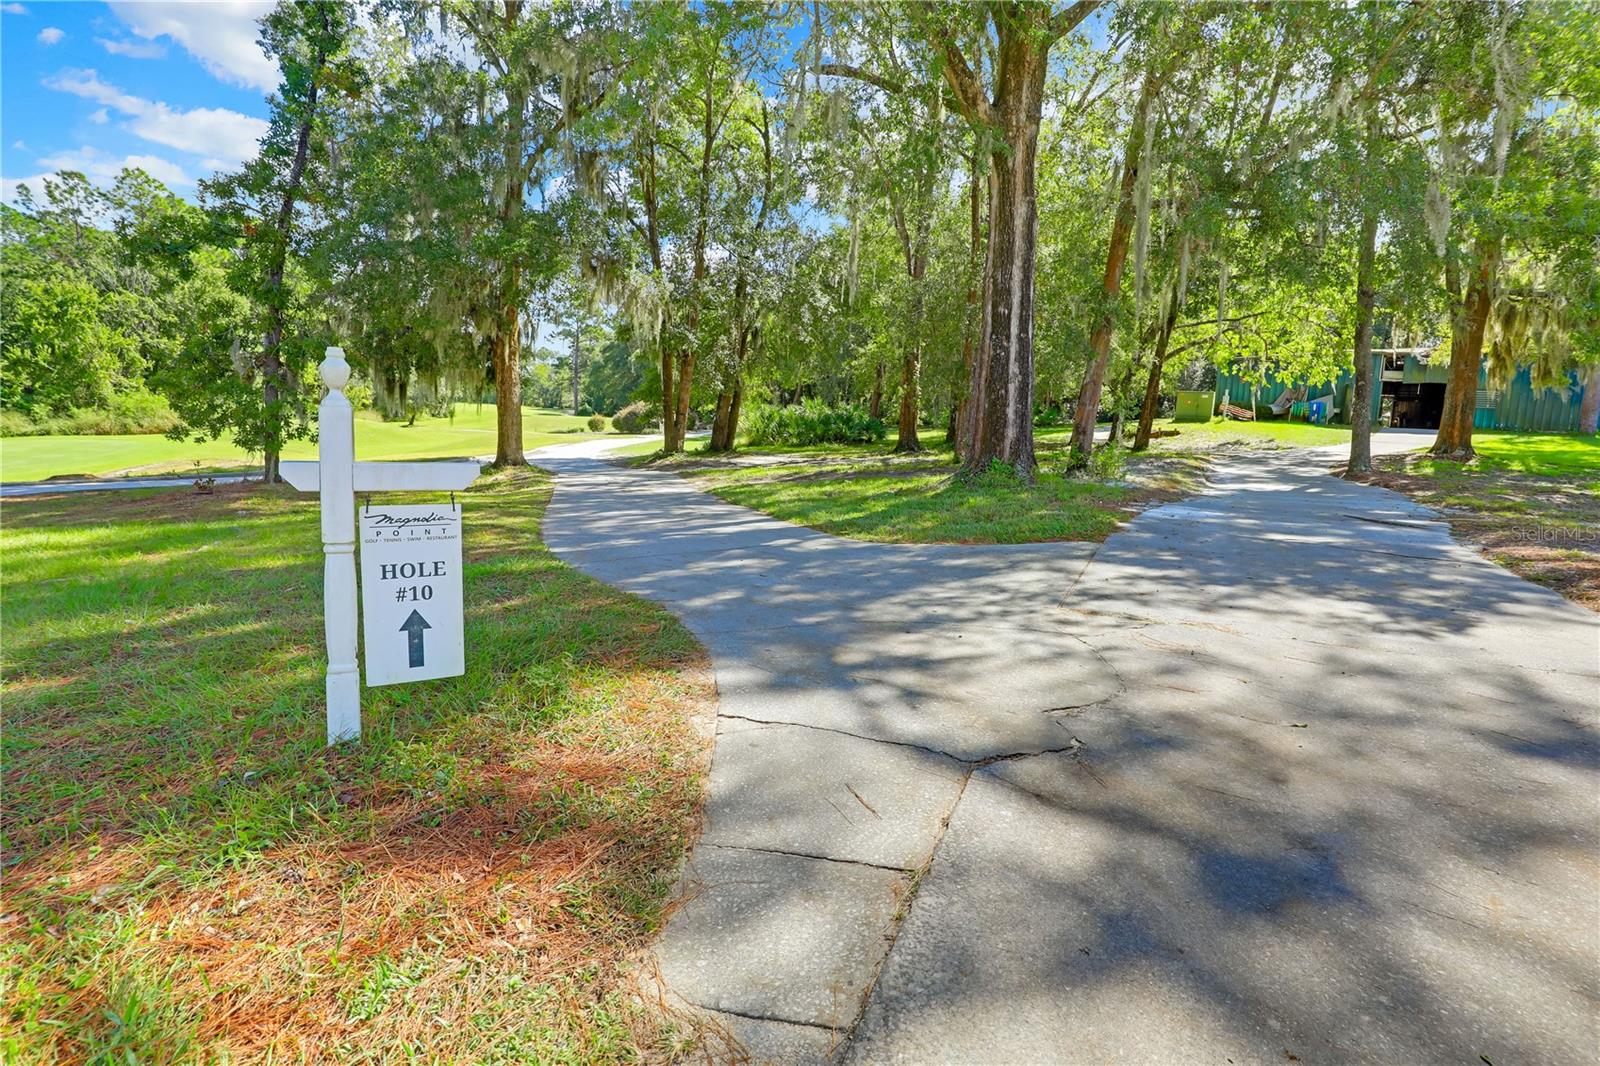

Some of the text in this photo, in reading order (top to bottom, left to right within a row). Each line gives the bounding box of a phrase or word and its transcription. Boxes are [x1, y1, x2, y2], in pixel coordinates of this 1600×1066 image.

[364, 512, 457, 529] Magnolia
[375, 528, 446, 537] POINT
[380, 561, 446, 580] HOLE
[395, 584, 433, 602] #10
